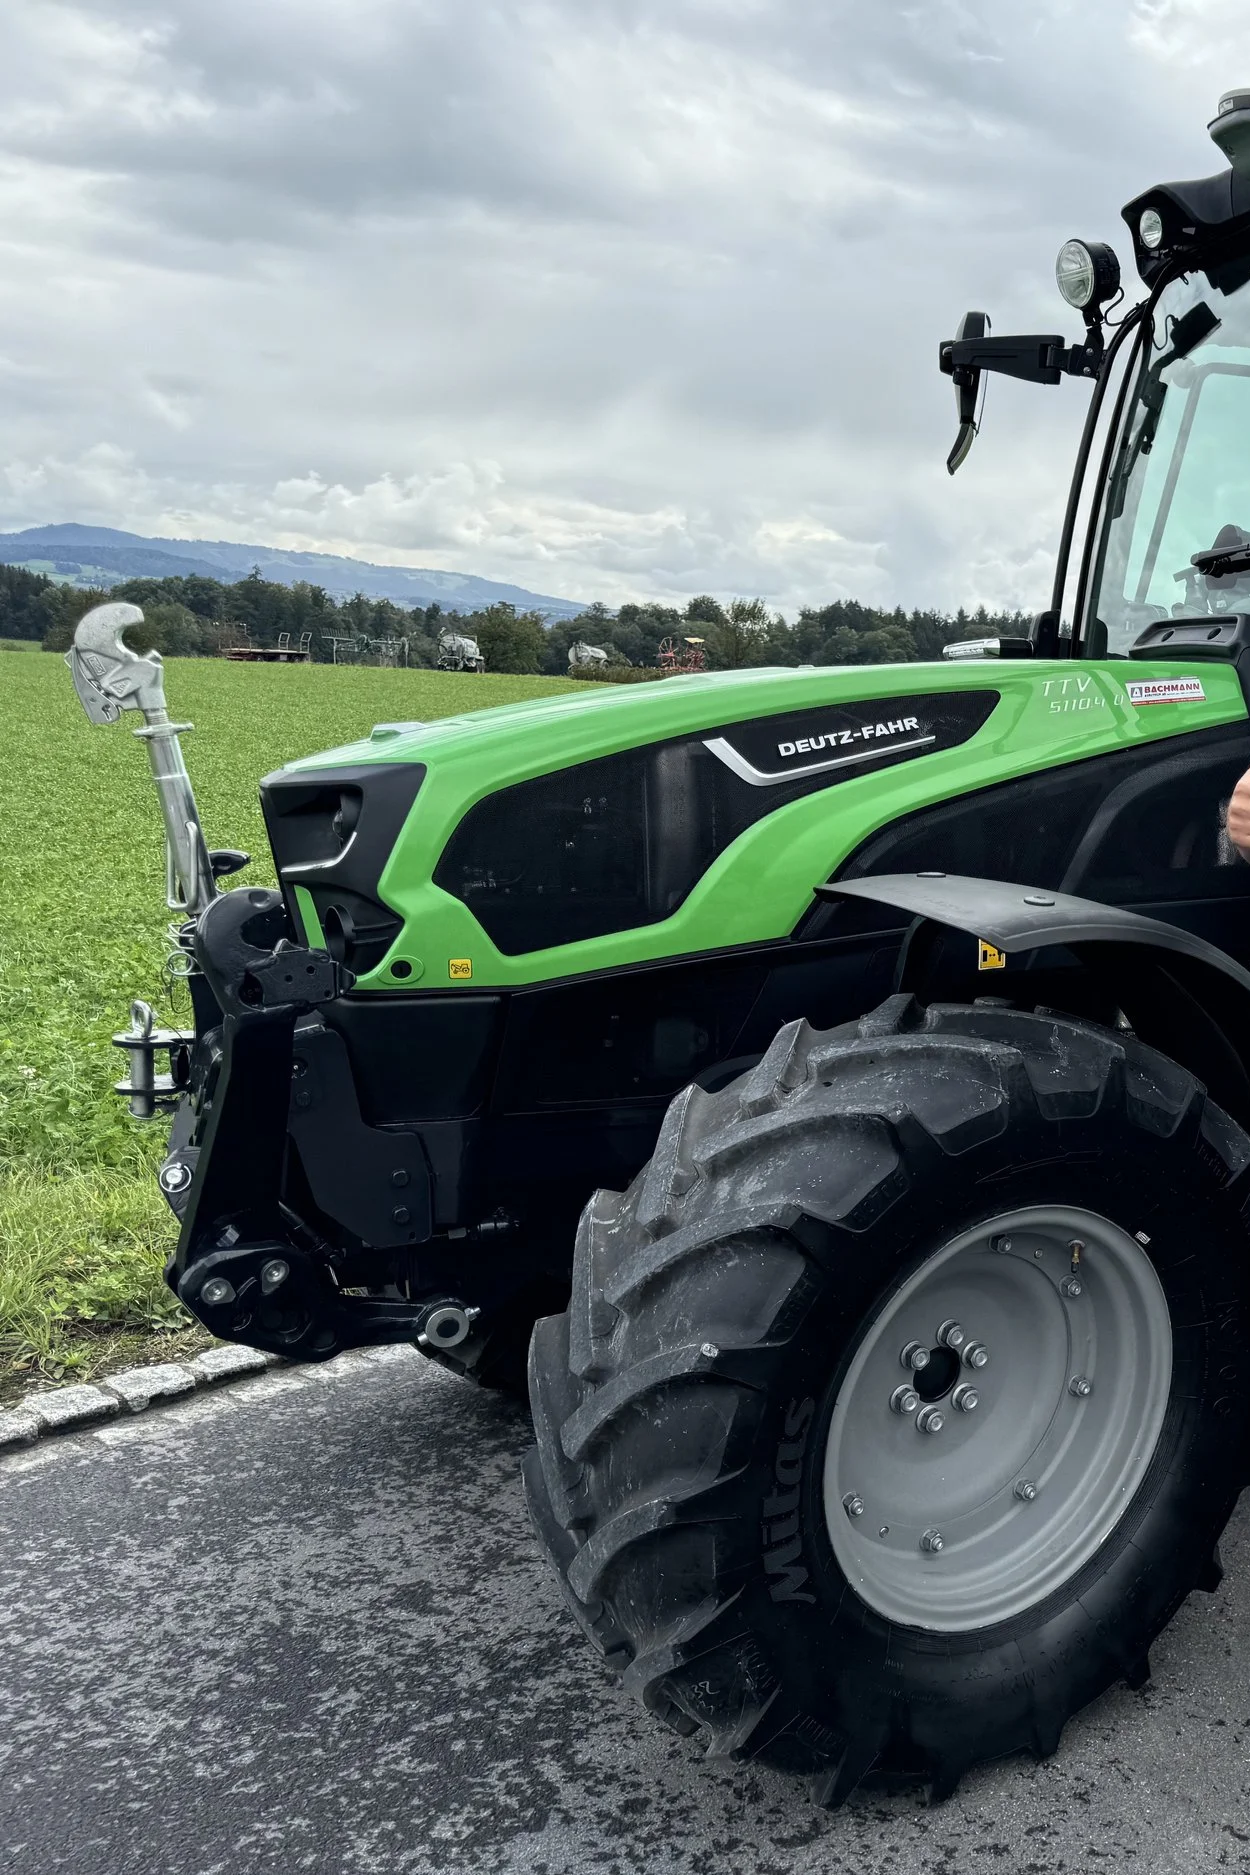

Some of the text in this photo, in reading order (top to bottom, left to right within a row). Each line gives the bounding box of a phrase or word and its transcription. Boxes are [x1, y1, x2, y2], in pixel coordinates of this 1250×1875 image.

[1041, 676, 1092, 697] TTV
[1144, 682, 1200, 694] BACHMANN
[777, 716, 920, 757] DEUTZ-FAHR
[762, 1396, 817, 1605] Mitas
